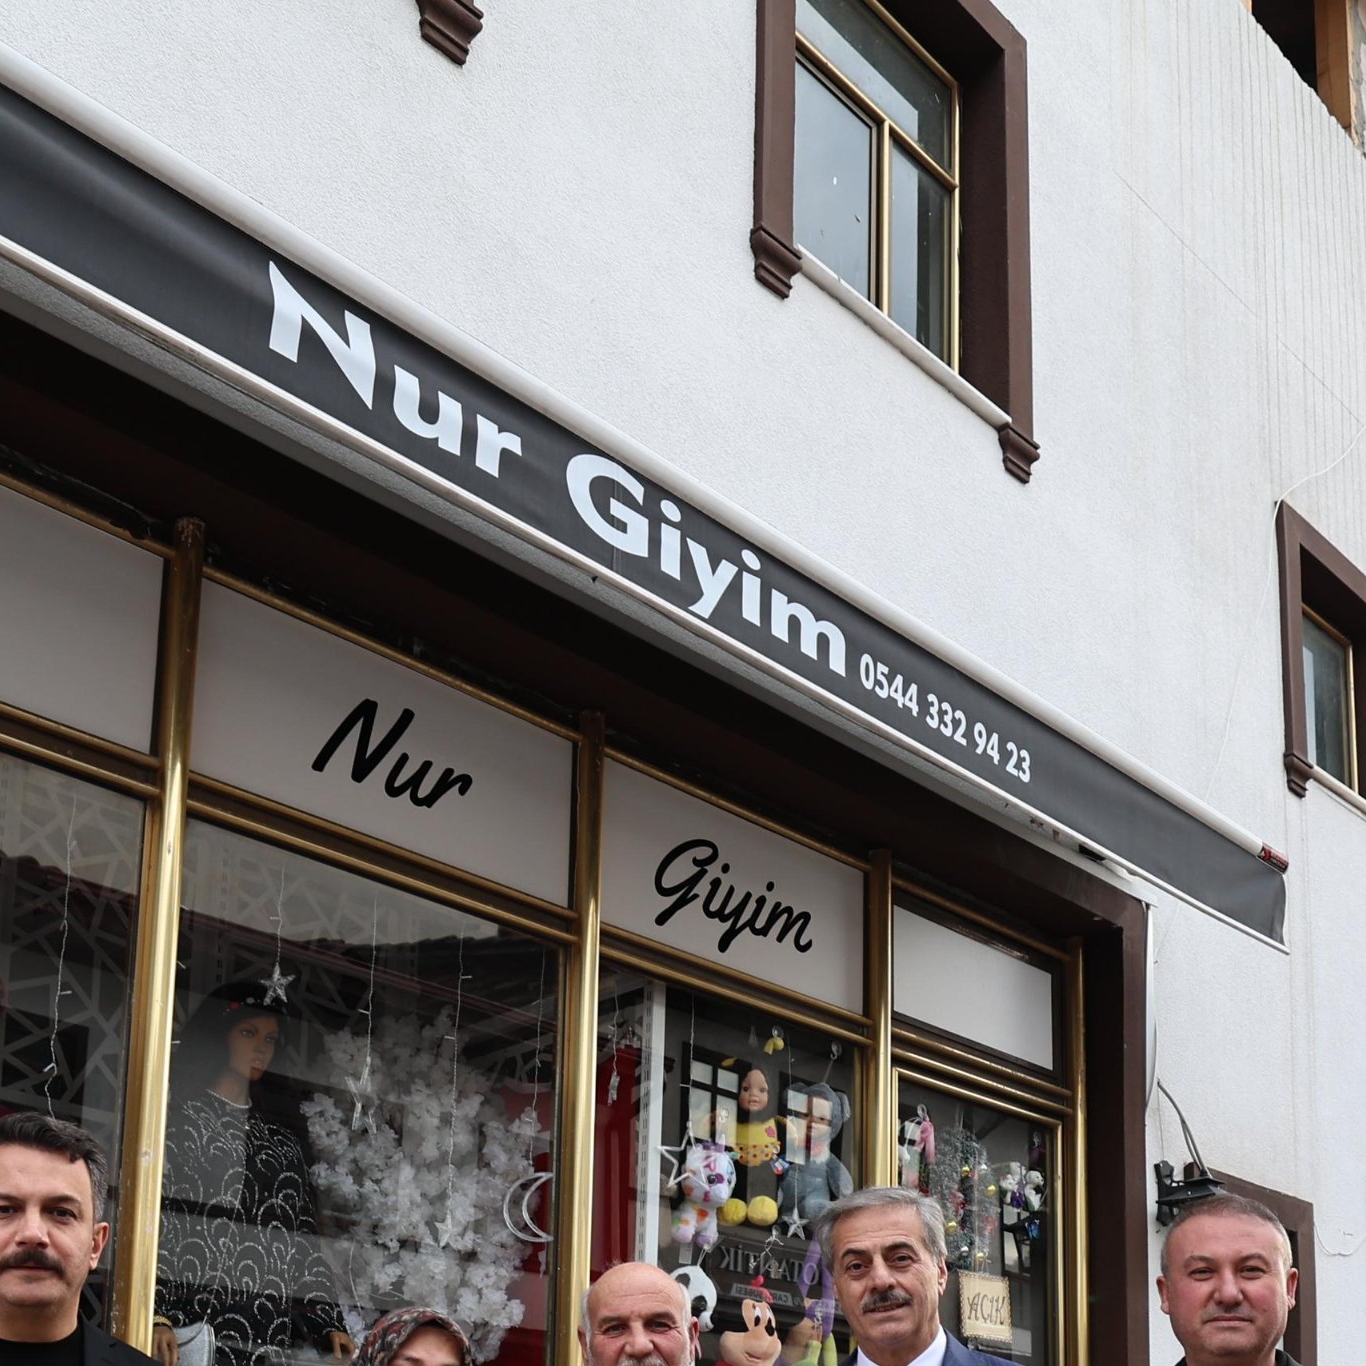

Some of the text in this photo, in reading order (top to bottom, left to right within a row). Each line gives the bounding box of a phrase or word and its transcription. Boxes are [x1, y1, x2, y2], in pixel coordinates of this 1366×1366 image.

[269, 260, 1032, 784] Nur Giyim 0544 332 94 23
[311, 699, 473, 808] Nur
[653, 837, 814, 954] Giyim
[967, 1292, 1006, 1326] AÇIK
